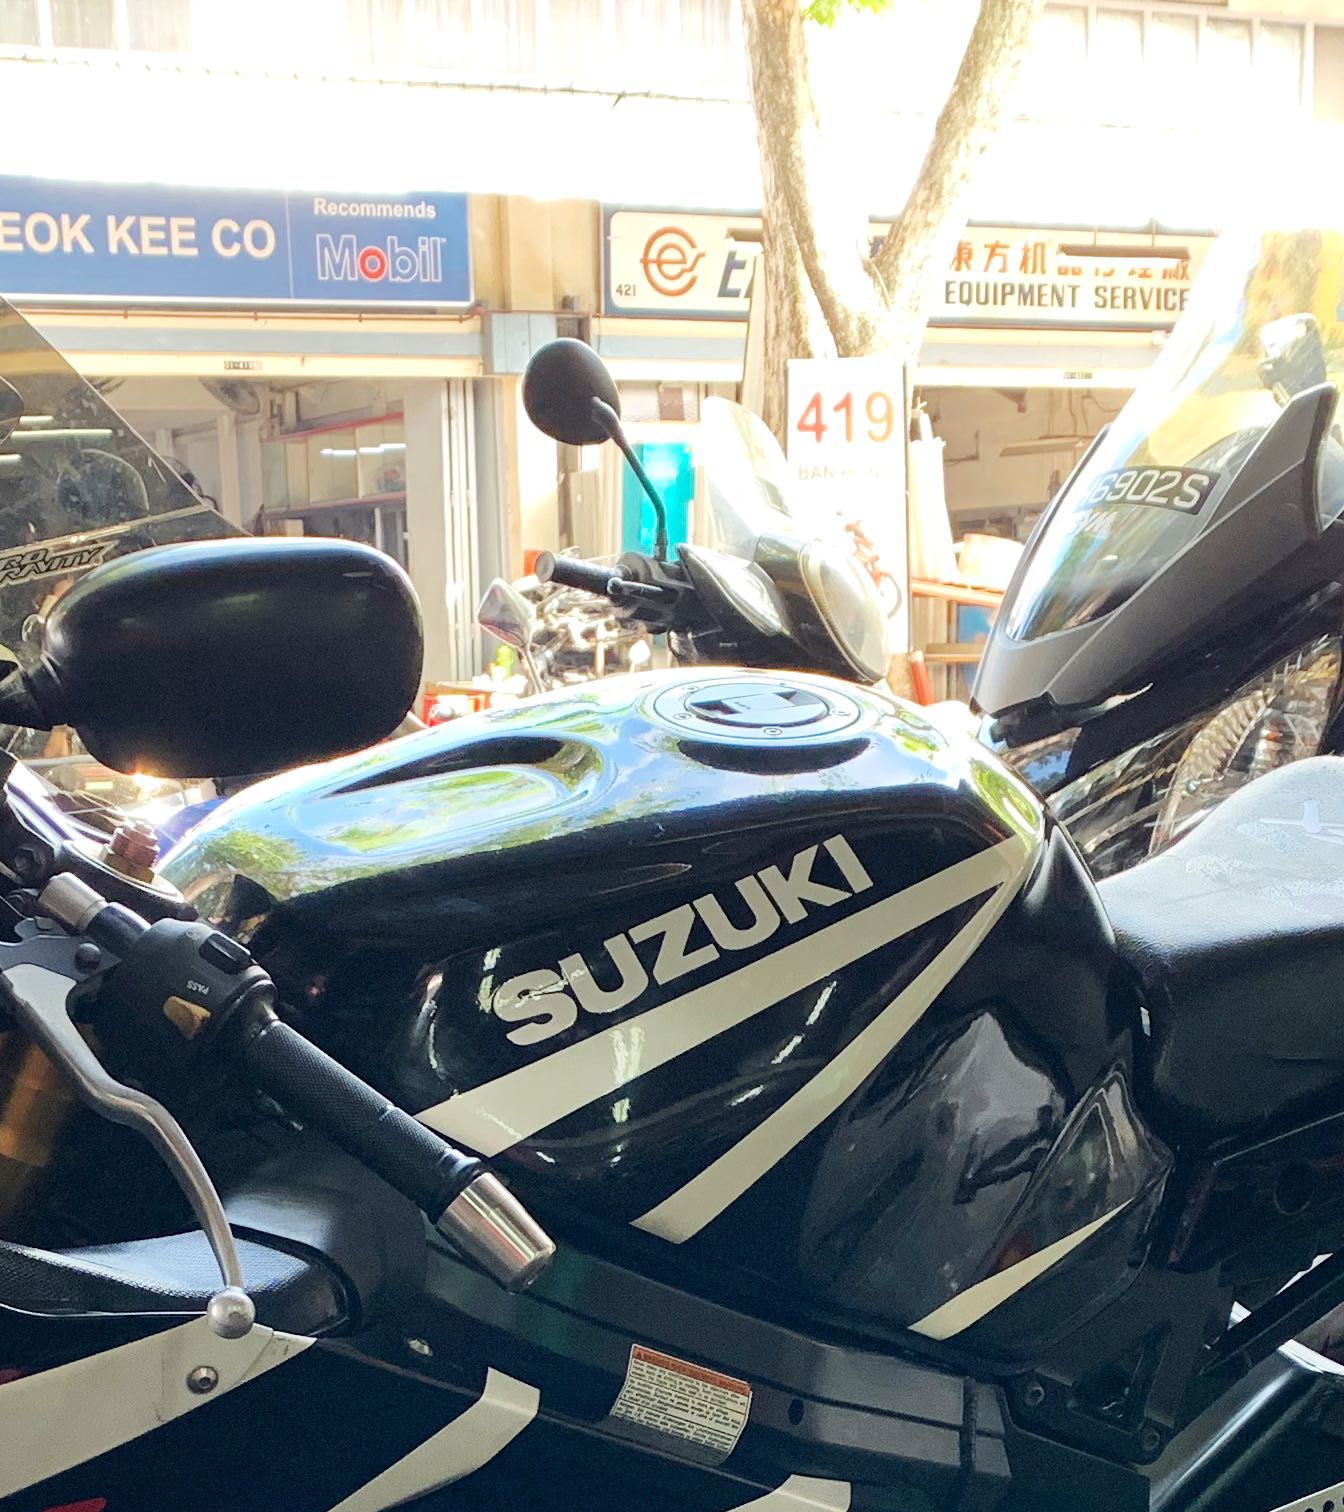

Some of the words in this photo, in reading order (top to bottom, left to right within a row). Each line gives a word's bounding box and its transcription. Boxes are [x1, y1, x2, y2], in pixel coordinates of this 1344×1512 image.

[313, 197, 437, 219] Recommends
[107, 214, 199, 257] KEE
[211, 218, 276, 259] CO
[315, 233, 443, 282] Mobil
[615, 284, 637, 297] 421
[944, 280, 1080, 308] EQUIPMENT
[796, 391, 895, 443] 419
[493, 834, 874, 1046] SUZUKI
[186, 980, 211, 996] PASS
